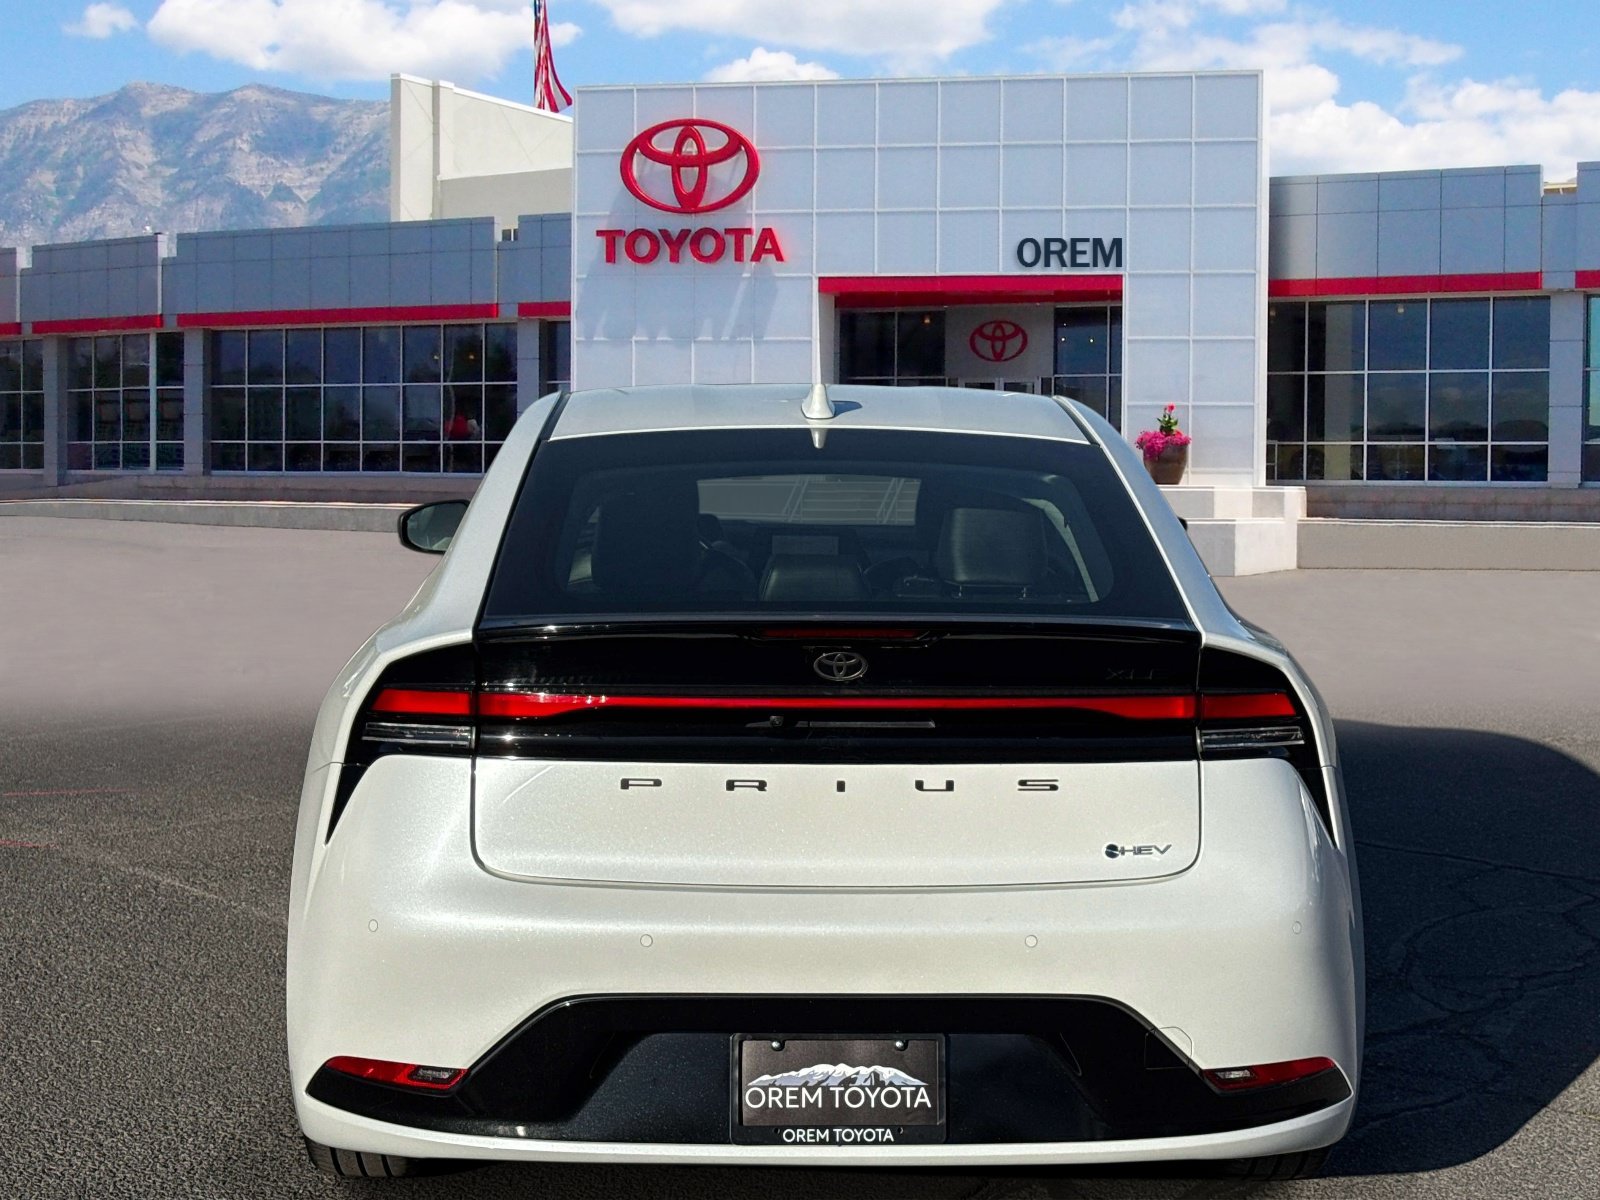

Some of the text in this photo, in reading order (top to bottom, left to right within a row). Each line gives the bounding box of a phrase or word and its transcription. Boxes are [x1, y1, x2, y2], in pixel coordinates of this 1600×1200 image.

[596, 227, 784, 264] TOYOTA
[1016, 237, 1123, 269] OREM
[620, 777, 1059, 793] PRIUS
[1120, 844, 1172, 856] HEV
[745, 1087, 931, 1108] OREM TOYOTA
[782, 1128, 894, 1142] OREM TOYOTA
